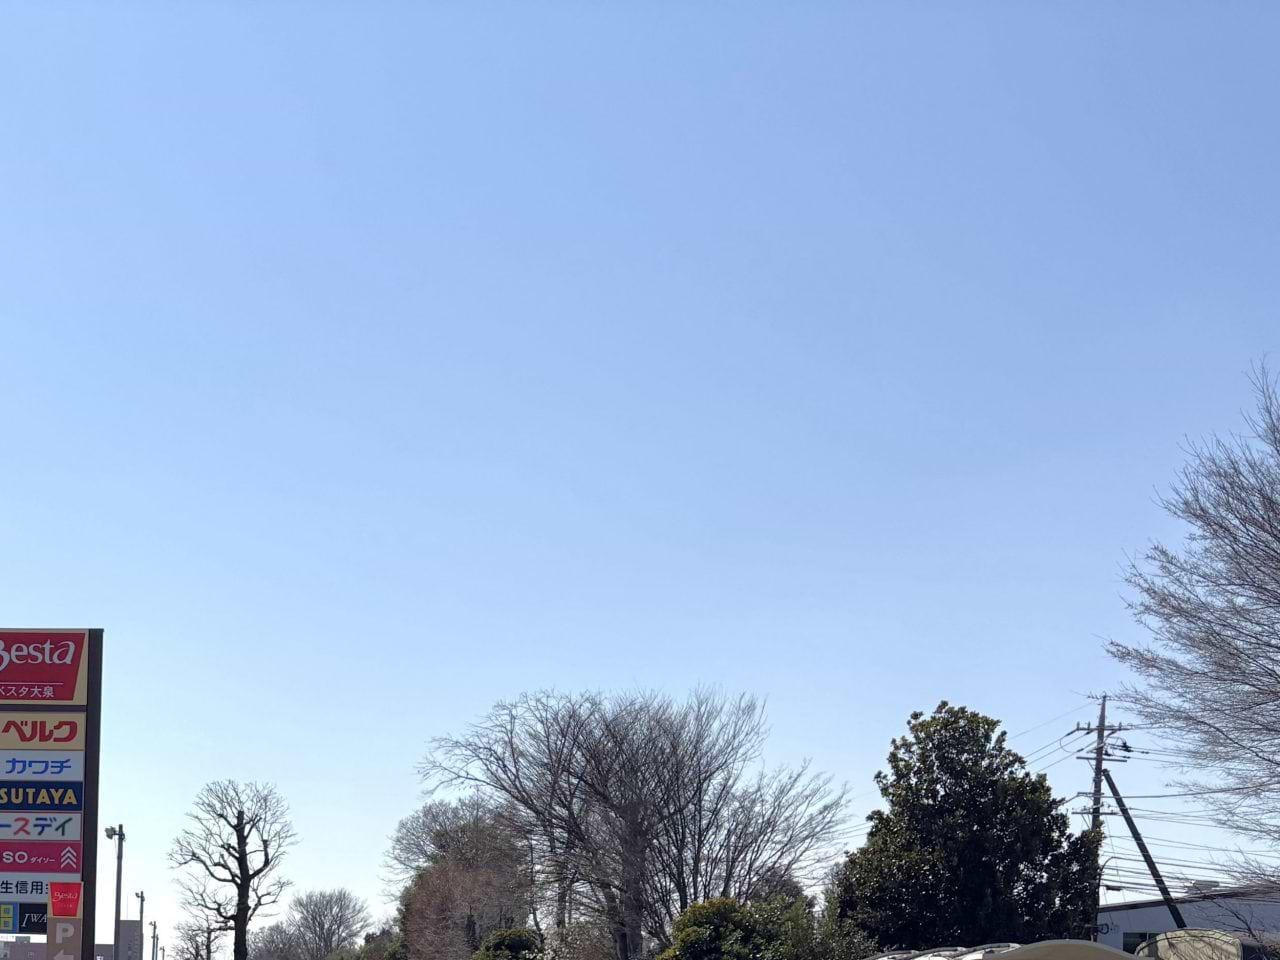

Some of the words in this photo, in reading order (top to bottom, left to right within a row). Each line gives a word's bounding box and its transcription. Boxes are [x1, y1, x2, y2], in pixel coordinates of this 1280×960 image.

[1, 720, 78, 743] ベルク
[5, 758, 72, 775] カワチ
[30, 856, 56, 864] ダイソー
[55, 922, 75, 944] P
